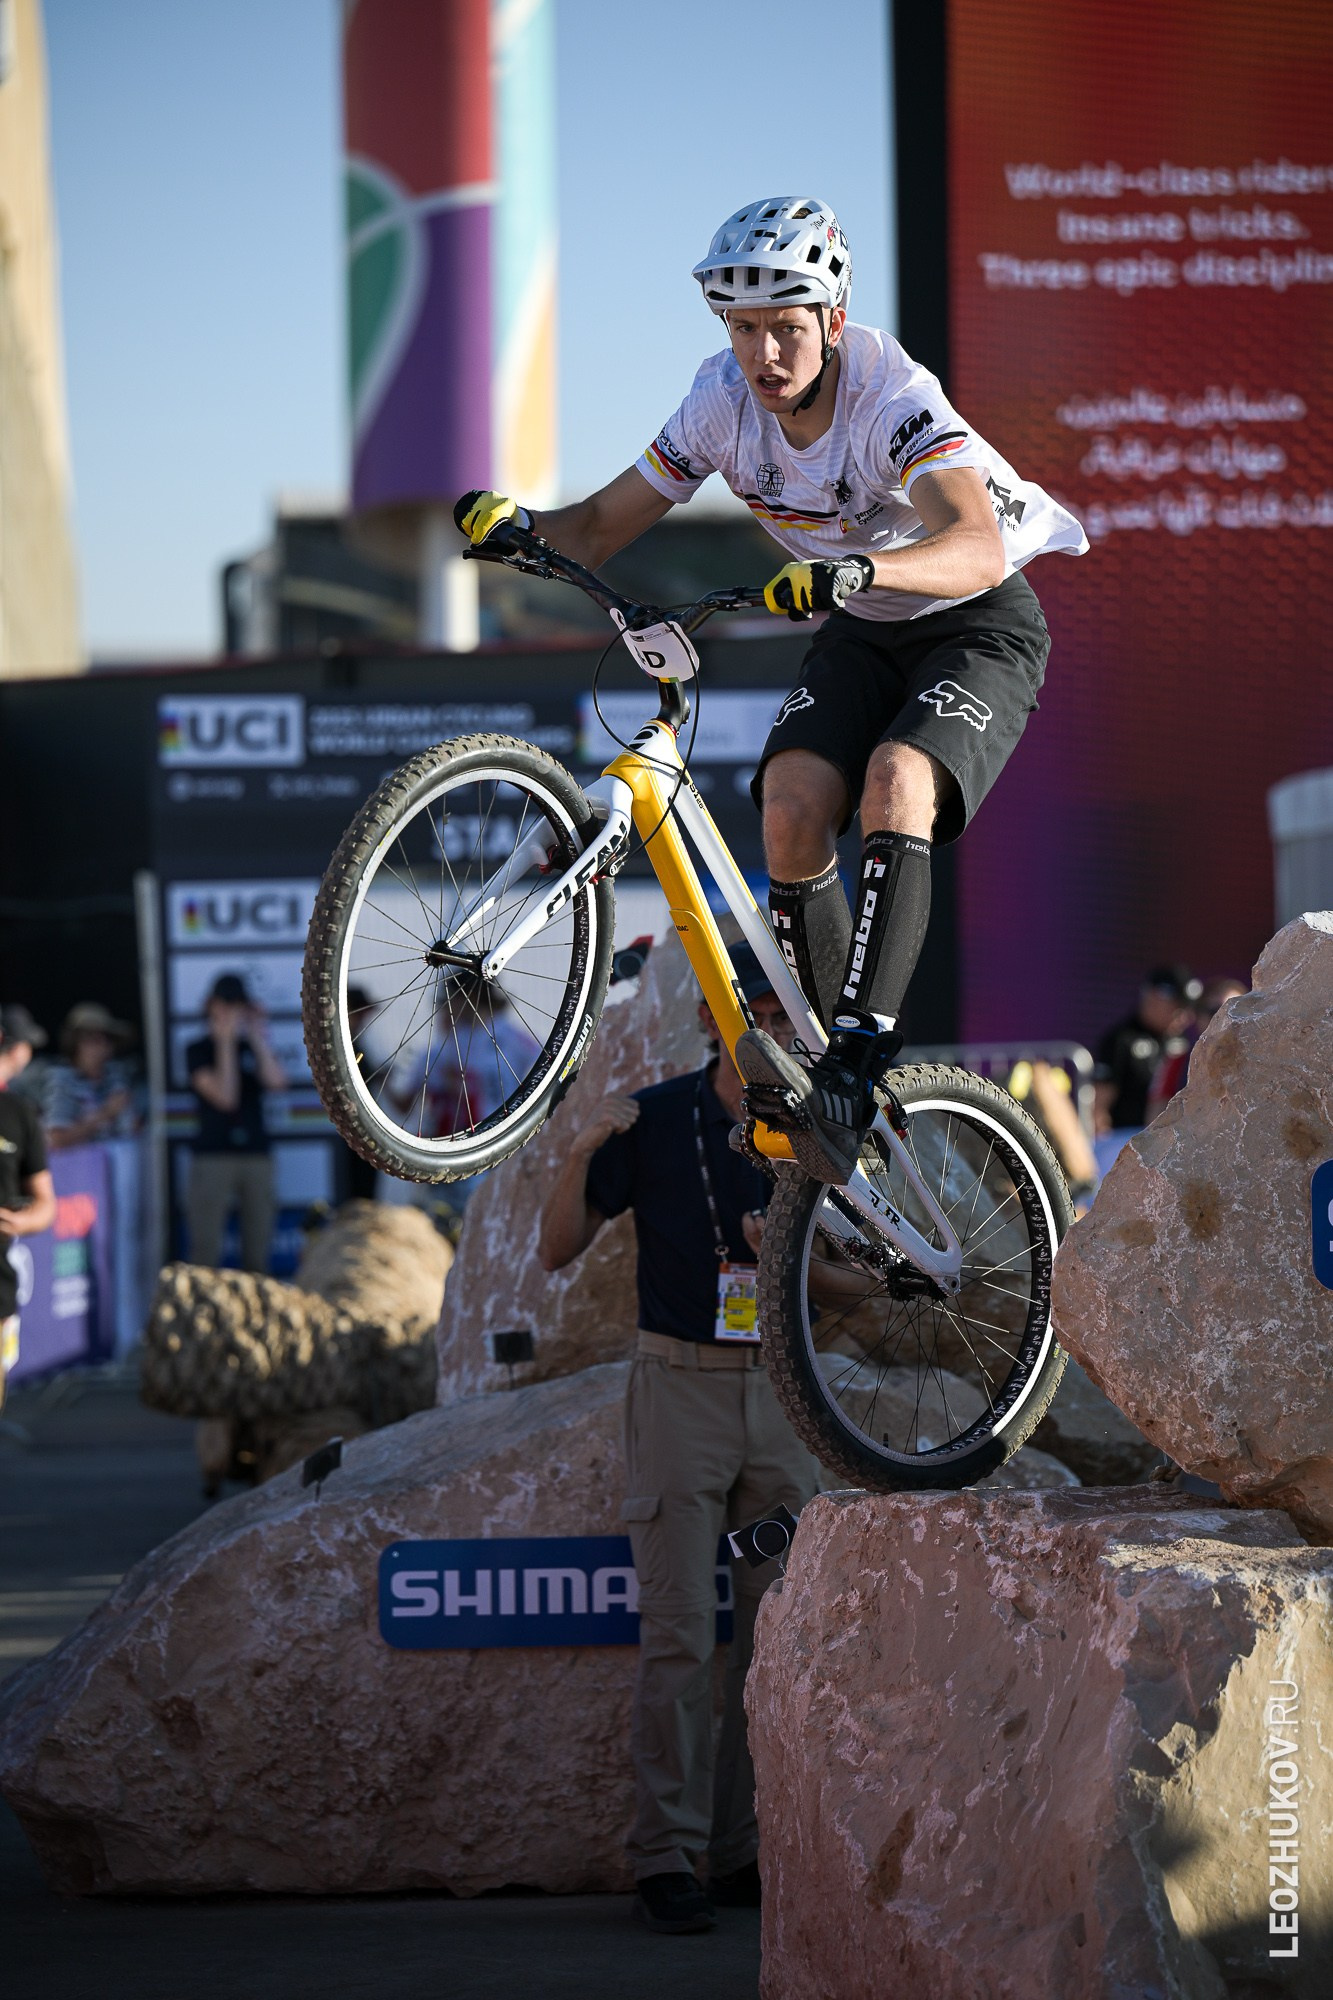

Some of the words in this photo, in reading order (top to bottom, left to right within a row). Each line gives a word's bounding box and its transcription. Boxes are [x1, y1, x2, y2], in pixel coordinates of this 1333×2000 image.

[1004, 161, 1235, 199] World-class
[1057, 209, 1187, 243] Insane
[977, 251, 1091, 290] Three
[1094, 250, 1182, 297] epic
[889, 409, 934, 464] KTM
[854, 501, 882, 520] german
[857, 506, 884, 526] cycling
[642, 650, 666, 669] D
[189, 710, 288, 752] UCI
[207, 895, 299, 933] UCI
[842, 889, 878, 1000] hebo
[391, 1566, 732, 1617] SHIMA
